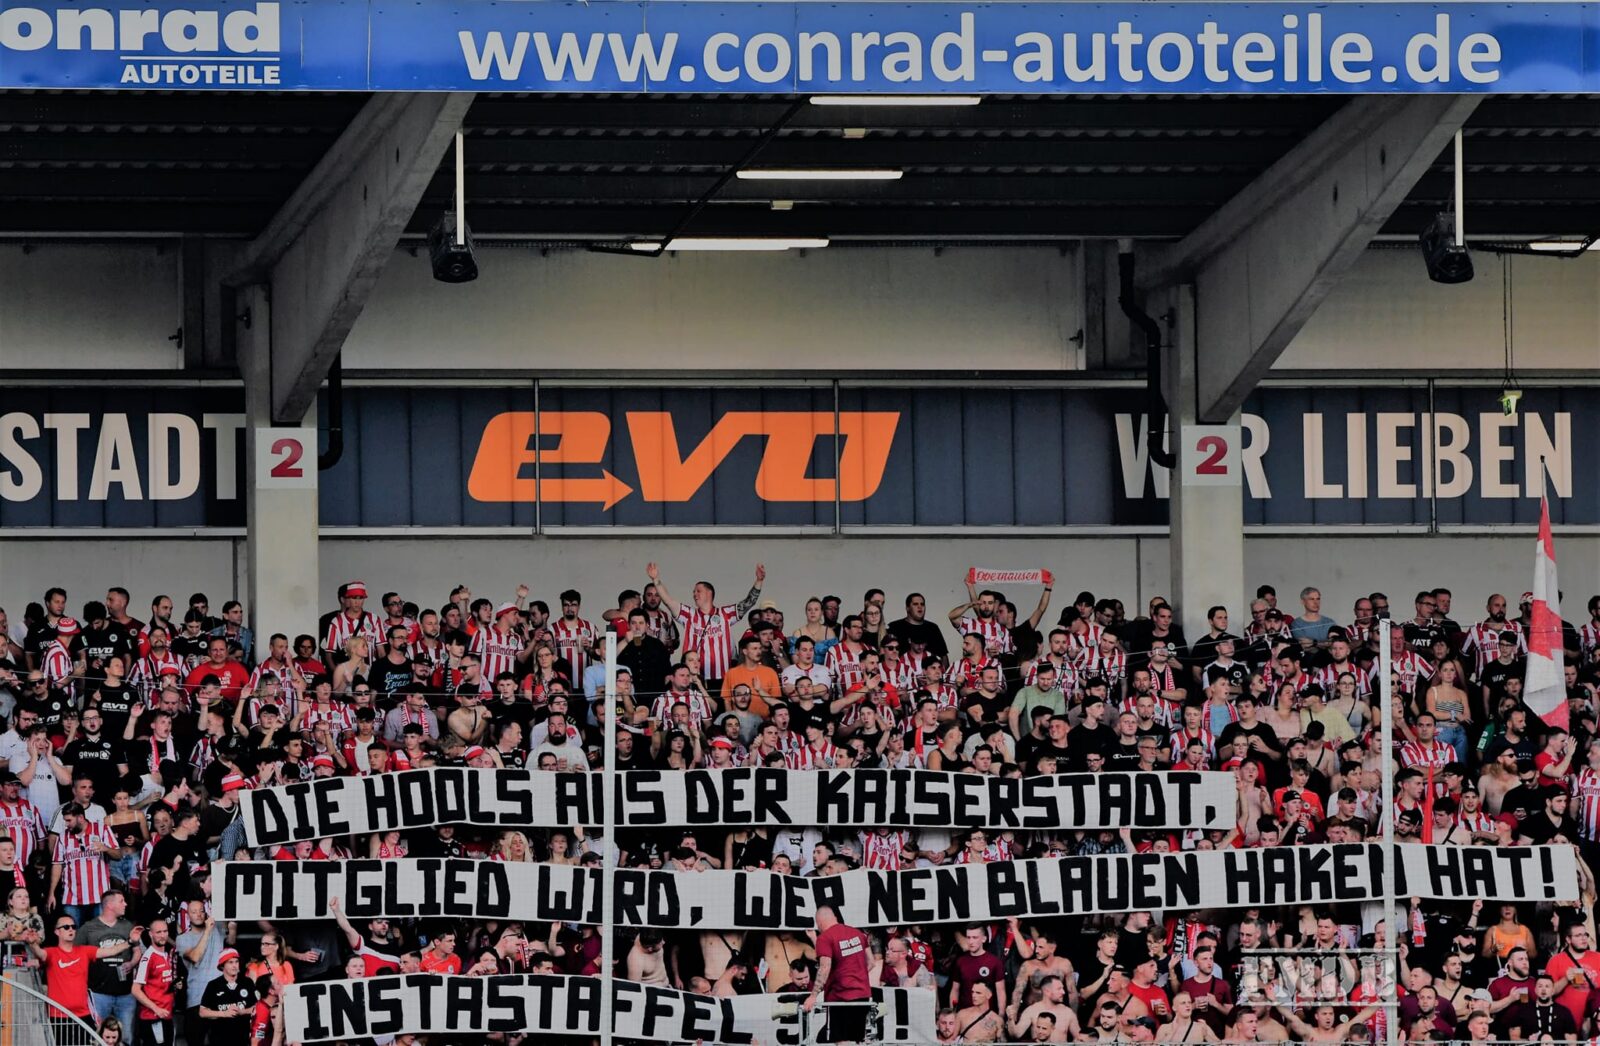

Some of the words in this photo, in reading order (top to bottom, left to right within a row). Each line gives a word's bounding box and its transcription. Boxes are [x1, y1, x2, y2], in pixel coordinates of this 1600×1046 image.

[0, 2, 280, 52] onrad
[459, 13, 1502, 83] www.conrad-autoteile.de
[120, 64, 280, 84] AUTOTEILE
[0, 412, 246, 501] STADT
[270, 438, 304, 478] 2
[1195, 435, 1229, 475] 2
[1303, 412, 1573, 499] LIEBEN
[251, 778, 350, 846] DIE
[363, 768, 534, 831] HOOLS
[555, 771, 667, 826] AUS
[684, 768, 792, 825] DER
[816, 769, 1217, 828] KAISERSTADT,
[224, 858, 511, 919] MITGLIED
[537, 864, 704, 927] WIRD,
[734, 872, 845, 928] WER
[868, 867, 970, 923] NEN
[986, 853, 1201, 917] BLAUEN
[1224, 843, 1409, 905] HAKEN
[1426, 846, 1556, 899] HAT!
[300, 974, 754, 1043] INSTASTAFFEL
